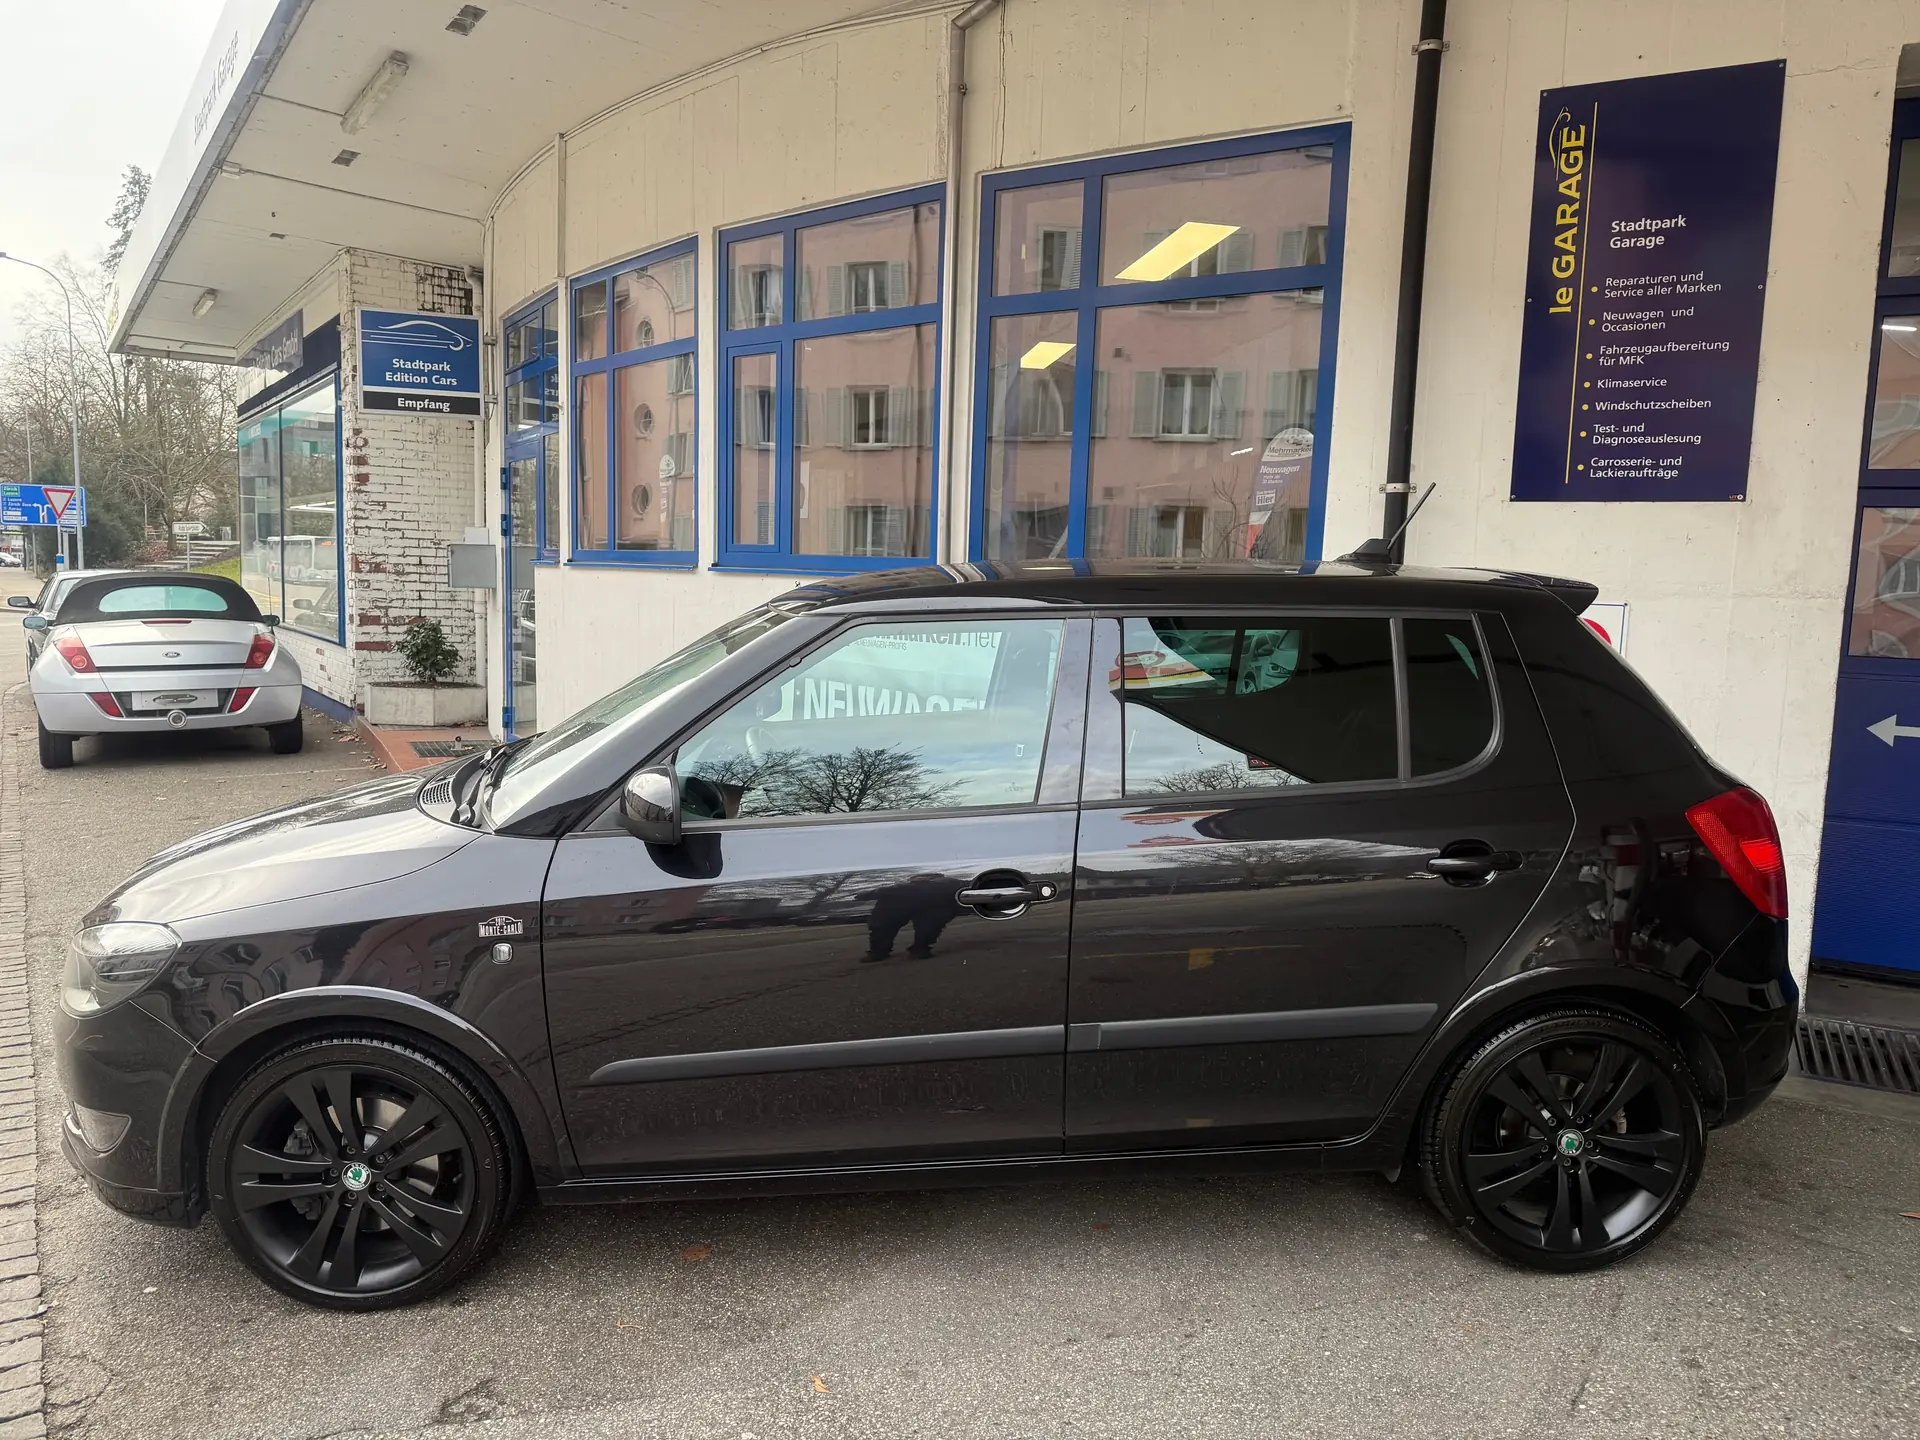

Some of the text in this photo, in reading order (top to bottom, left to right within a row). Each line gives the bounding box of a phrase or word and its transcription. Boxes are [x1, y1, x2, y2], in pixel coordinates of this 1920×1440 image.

[1549, 125, 1586, 314] le GARAGE
[1610, 214, 1687, 232] Stadtpark
[1609, 235, 1665, 249] Garage
[1605, 271, 1703, 288] Reparaturen und
[1604, 282, 1722, 298] Service aller Marken
[1602, 307, 1694, 322] Neuwagen und
[1601, 320, 1666, 332] Occasionen
[1600, 340, 1730, 356] Fahrzeugaufbereitung
[392, 358, 451, 372] Stadtpark
[1599, 355, 1645, 366] für MFK
[385, 372, 457, 386] Edition Cars
[1597, 377, 1667, 389] Klimaservice
[397, 398, 451, 412] Empfang
[1595, 399, 1712, 411] Windschutzscheiben
[1593, 423, 1644, 433] Test- und
[1592, 433, 1701, 447] Diagnoseauslesung
[1590, 456, 1682, 467] Carrosserie- und
[1590, 467, 1679, 480] Lackieraufträge
